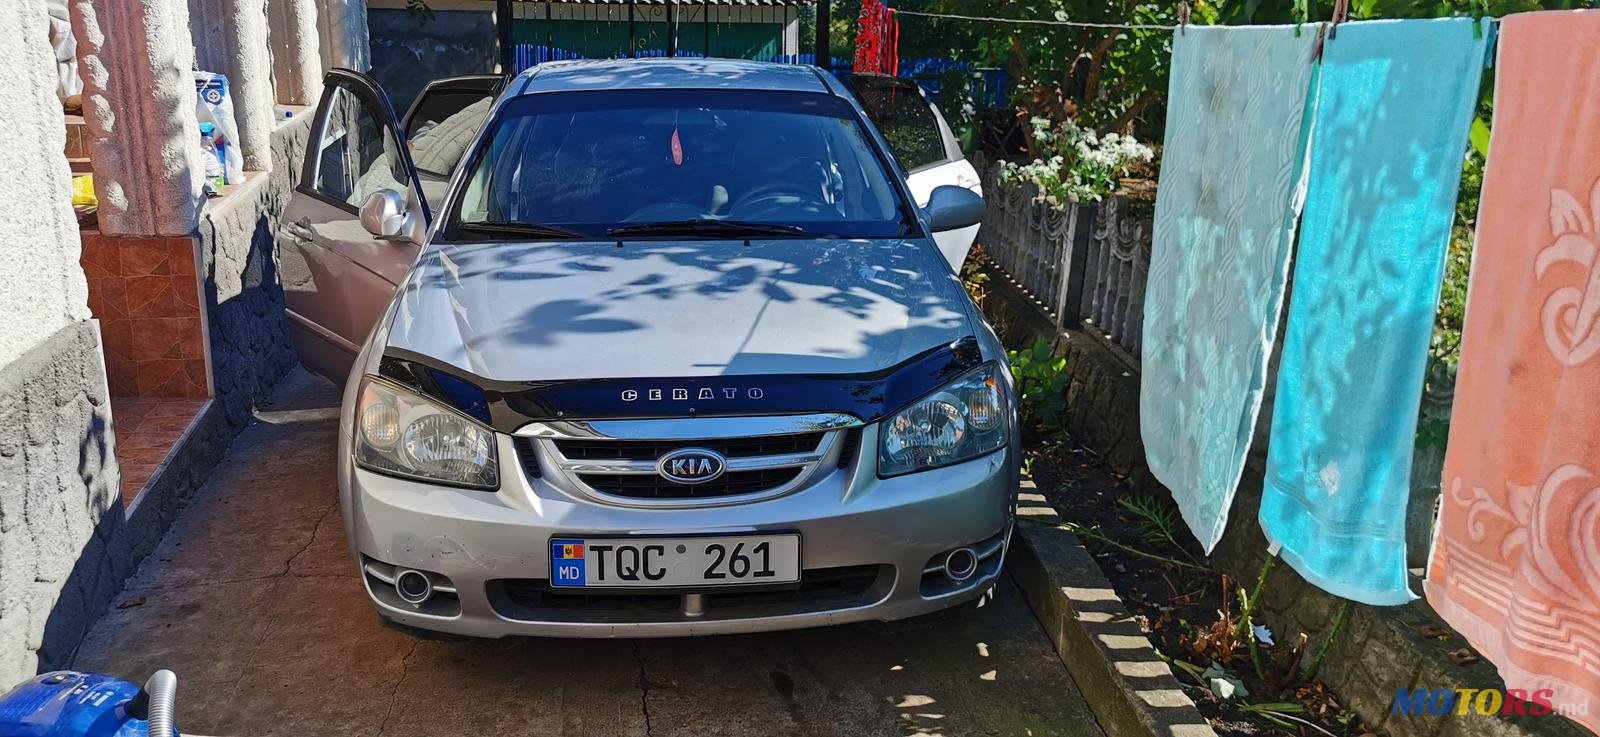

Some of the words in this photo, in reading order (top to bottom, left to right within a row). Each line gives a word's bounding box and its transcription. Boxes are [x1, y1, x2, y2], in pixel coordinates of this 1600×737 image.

[621, 387, 764, 402] CERATO
[671, 458, 713, 475] KIA
[589, 544, 667, 581] TQC
[703, 541, 776, 580] 261
[558, 566, 580, 580] MD
